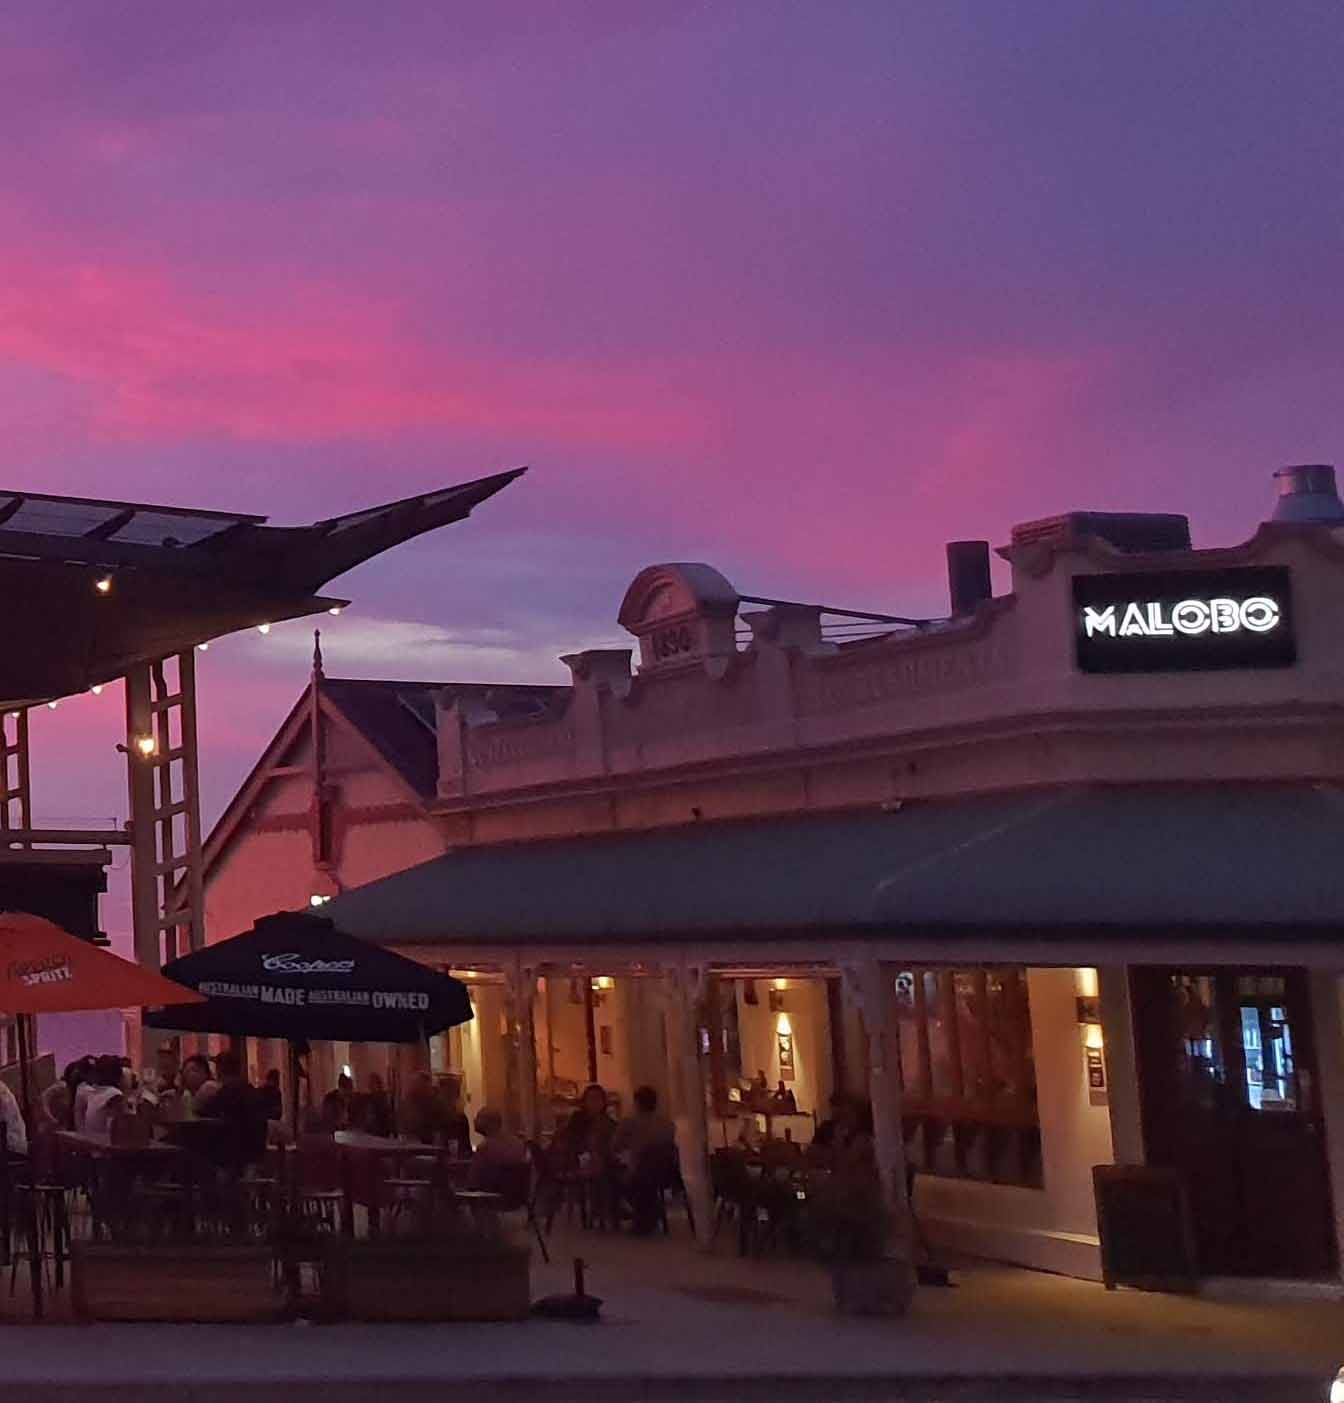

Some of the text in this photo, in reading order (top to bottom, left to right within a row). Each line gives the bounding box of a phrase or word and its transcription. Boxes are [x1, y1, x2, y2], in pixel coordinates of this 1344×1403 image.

[1083, 596, 1280, 638] MALOBO
[260, 987, 305, 1006] MADE
[372, 993, 429, 1009] OWNED
